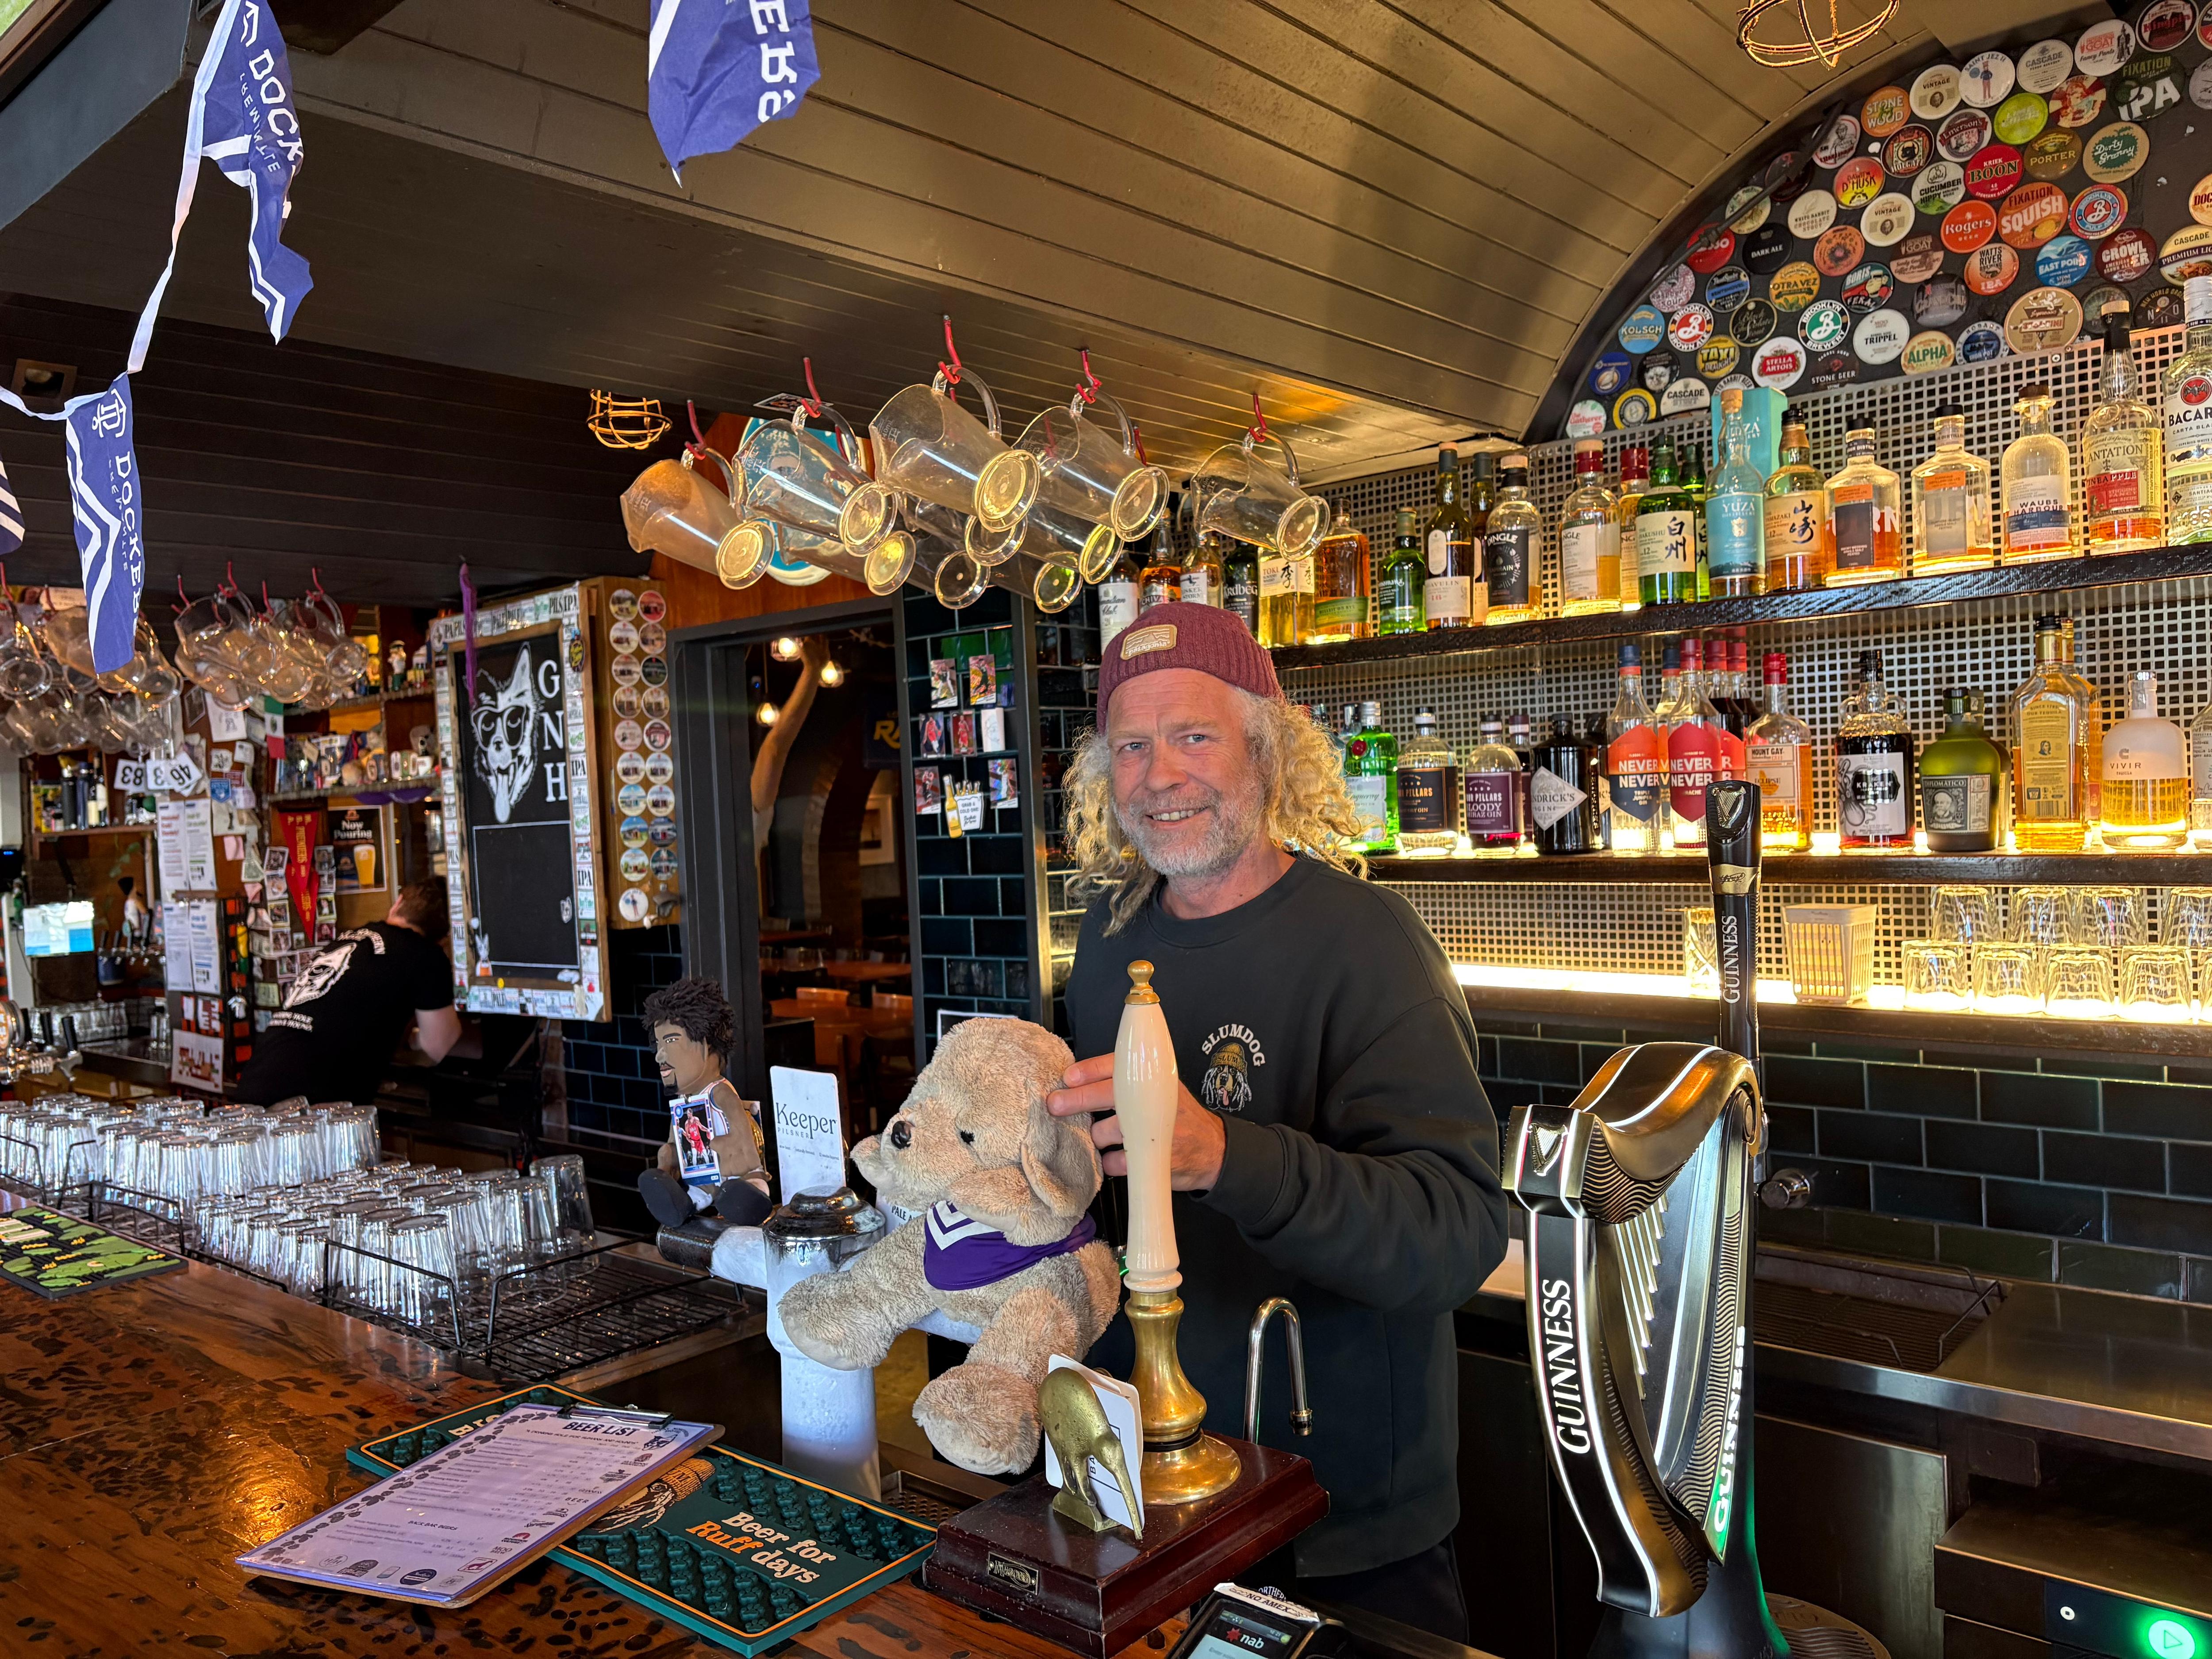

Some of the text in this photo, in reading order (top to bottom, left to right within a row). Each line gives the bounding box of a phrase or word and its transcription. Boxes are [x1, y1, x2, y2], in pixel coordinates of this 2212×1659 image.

[2086, 37, 2113, 51] GOAT
[2026, 51, 2063, 67] CASCADE
[2098, 48, 2115, 57] Pants
[1965, 55, 1985, 73] SAINT
[2124, 56, 2171, 77] FIXATION
[1923, 78, 1951, 89] VINTAGE
[1866, 96, 1904, 115] STONE
[1867, 110, 1904, 129] WOOD
[1943, 119, 1983, 140] Emerson's
[1983, 157, 2003, 166] KRIEK
[2030, 150, 2076, 165] PORTER
[1970, 160, 2020, 182] BOON
[1842, 176, 1876, 192] D'HUSK
[1920, 178, 1962, 196] CUCUMBER
[2008, 185, 2053, 207] FIXATION
[2080, 193, 2112, 209] BROOKLYN
[1811, 210, 1830, 219] RABBIT
[1875, 207, 1902, 216] VINTAGE
[2001, 195, 2063, 234] SQUISH
[1946, 219, 1992, 235] Rogers
[2174, 232, 2209, 245] CASCADE
[1751, 249, 1770, 258] DARK
[1906, 241, 1932, 252] GOAT
[1979, 246, 2002, 256] WATTS
[2102, 240, 2147, 262] CROWL
[1979, 253, 2002, 265] RIVER
[2162, 248, 2198, 265] PREMIUM
[1845, 265, 1871, 286] BORIS
[2039, 261, 2060, 275] EAST
[1773, 278, 1818, 291] OTRA VEZ
[2151, 288, 2169, 299] WORLD
[1675, 305, 1711, 321] BROOKLYN
[1802, 301, 1842, 323] BROOKLYN
[2147, 303, 2179, 321] N O
[1621, 325, 1662, 335] KOLSCH
[1966, 323, 2000, 334] HOBART
[1670, 332, 1710, 350] BROWN ALE
[1806, 330, 1845, 350] BREWERY
[1864, 334, 1897, 345] TRIPPEL
[1701, 347, 1736, 360] TAXI
[1766, 357, 1793, 365] STELLA
[1908, 345, 1948, 364] ALPHA
[1705, 358, 1732, 373] DRAUGHT
[1766, 363, 1793, 373] ARTOIS
[1811, 370, 1856, 384] STONE BEER
[1667, 389, 1705, 398] CASCADE
[1570, 415, 1603, 424] Gatherer
[1722, 502, 1755, 514] YUZA
[2013, 504, 2064, 516] HARBOUR
[2020, 499, 2059, 509] WAUBS
[1790, 499, 1816, 544] 山崎
[1487, 534, 1519, 546] DINGLE
[1665, 516, 1687, 562] 白州
[1281, 562, 1294, 588] 季
[549, 596, 563, 615] PILS
[1127, 641, 1169, 657] patagonia
[538, 659, 560, 699] G
[542, 711, 564, 751] N
[1751, 748, 1769, 756] MOUNT
[571, 762, 586, 776] IPA
[1618, 758, 1659, 772] NEVER
[1671, 757, 1713, 771] NEVER
[544, 762, 568, 802] H
[1619, 773, 1659, 788] NEVER
[1671, 773, 1713, 787] NEVER
[1406, 787, 1432, 797] PILLARS
[1475, 793, 1502, 802] PILLARS
[342, 820, 364, 830] Now
[334, 829, 373, 839] Pouring
[447, 850, 460, 864] PILS
[578, 868, 593, 887] IPA
[1723, 915, 1740, 1004] GUINNESS
[492, 992, 506, 1007] PALE
[1202, 1023, 1266, 1067] SLUMDOG
[1218, 1054, 1238, 1063] SLUM
[775, 1102, 837, 1140] Keeper
[777, 1127, 810, 1139] PILSNER
[891, 1205, 906, 1220] PALE
[1541, 1279, 1592, 1455] GUINNESS
[562, 1422, 640, 1437] BEER LIST
[1714, 1326, 1745, 1532] GUINNESS
[721, 1511, 837, 1564] Beer for
[685, 1520, 821, 1585] Ruff days
[1247, 1593, 1291, 1613] NO AMEX
[1240, 1633, 1264, 1649] nab
